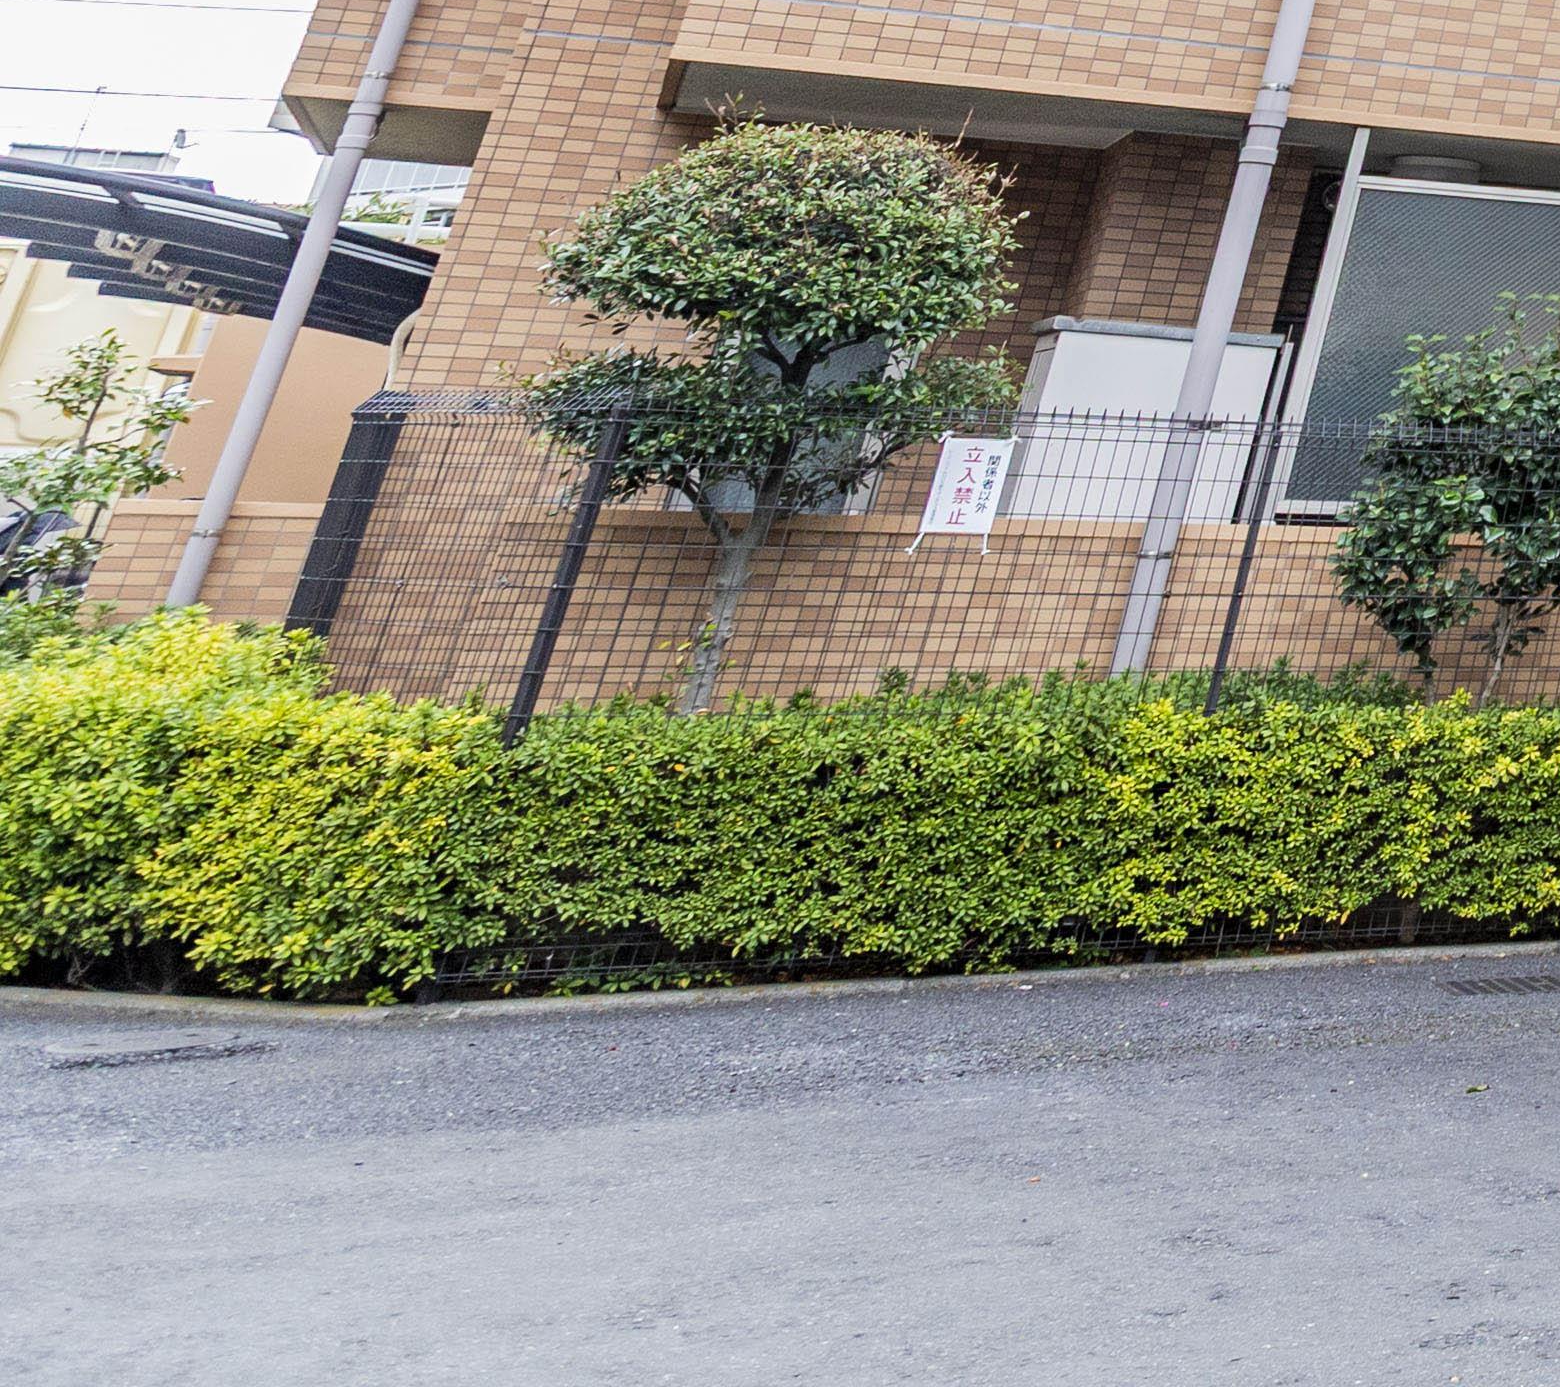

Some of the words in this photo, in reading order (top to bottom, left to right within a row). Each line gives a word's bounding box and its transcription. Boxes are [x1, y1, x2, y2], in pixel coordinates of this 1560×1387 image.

[945, 446, 985, 525] 立入禁止
[975, 454, 1002, 514] 関係者以外
